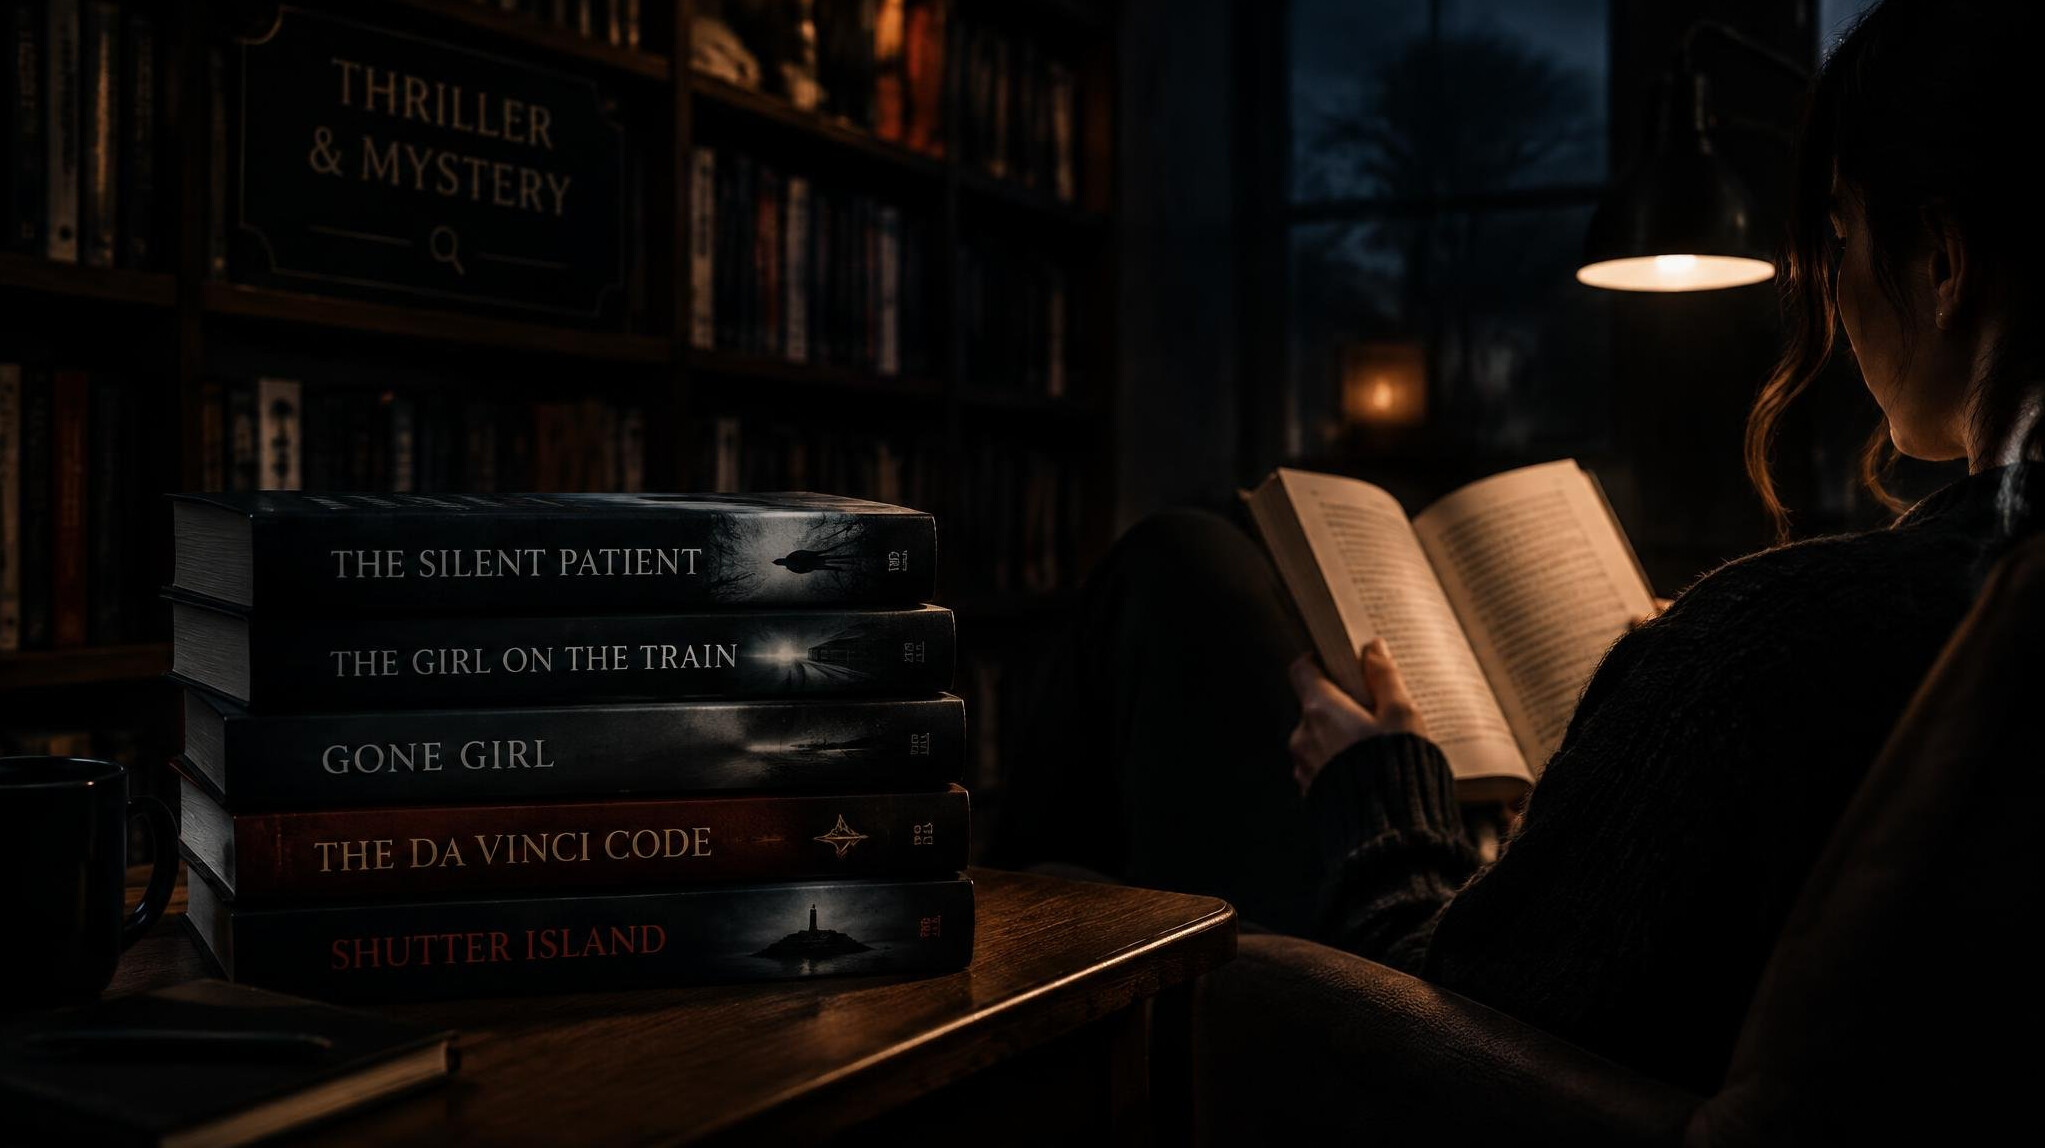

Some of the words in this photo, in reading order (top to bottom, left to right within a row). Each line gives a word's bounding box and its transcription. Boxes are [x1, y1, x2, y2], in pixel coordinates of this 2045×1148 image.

[331, 57, 554, 152] THRILLER
[307, 125, 343, 176] &
[361, 134, 572, 217] MYSTERY
[330, 549, 405, 578] THE
[419, 548, 546, 578] SILENT
[559, 548, 702, 576] PATIENT
[329, 649, 399, 677] THE
[412, 648, 491, 675] GIRL
[502, 647, 554, 673] ON
[564, 645, 629, 671] THE
[639, 643, 738, 670] TRAIN
[322, 742, 443, 775] GONE
[460, 739, 555, 770] GIRL
[313, 840, 395, 872] THE
[408, 837, 465, 868] DA
[475, 832, 591, 865] VINCI
[604, 826, 713, 860] CODE
[331, 933, 512, 971] SHUTTER
[525, 924, 667, 960] ISLAND
